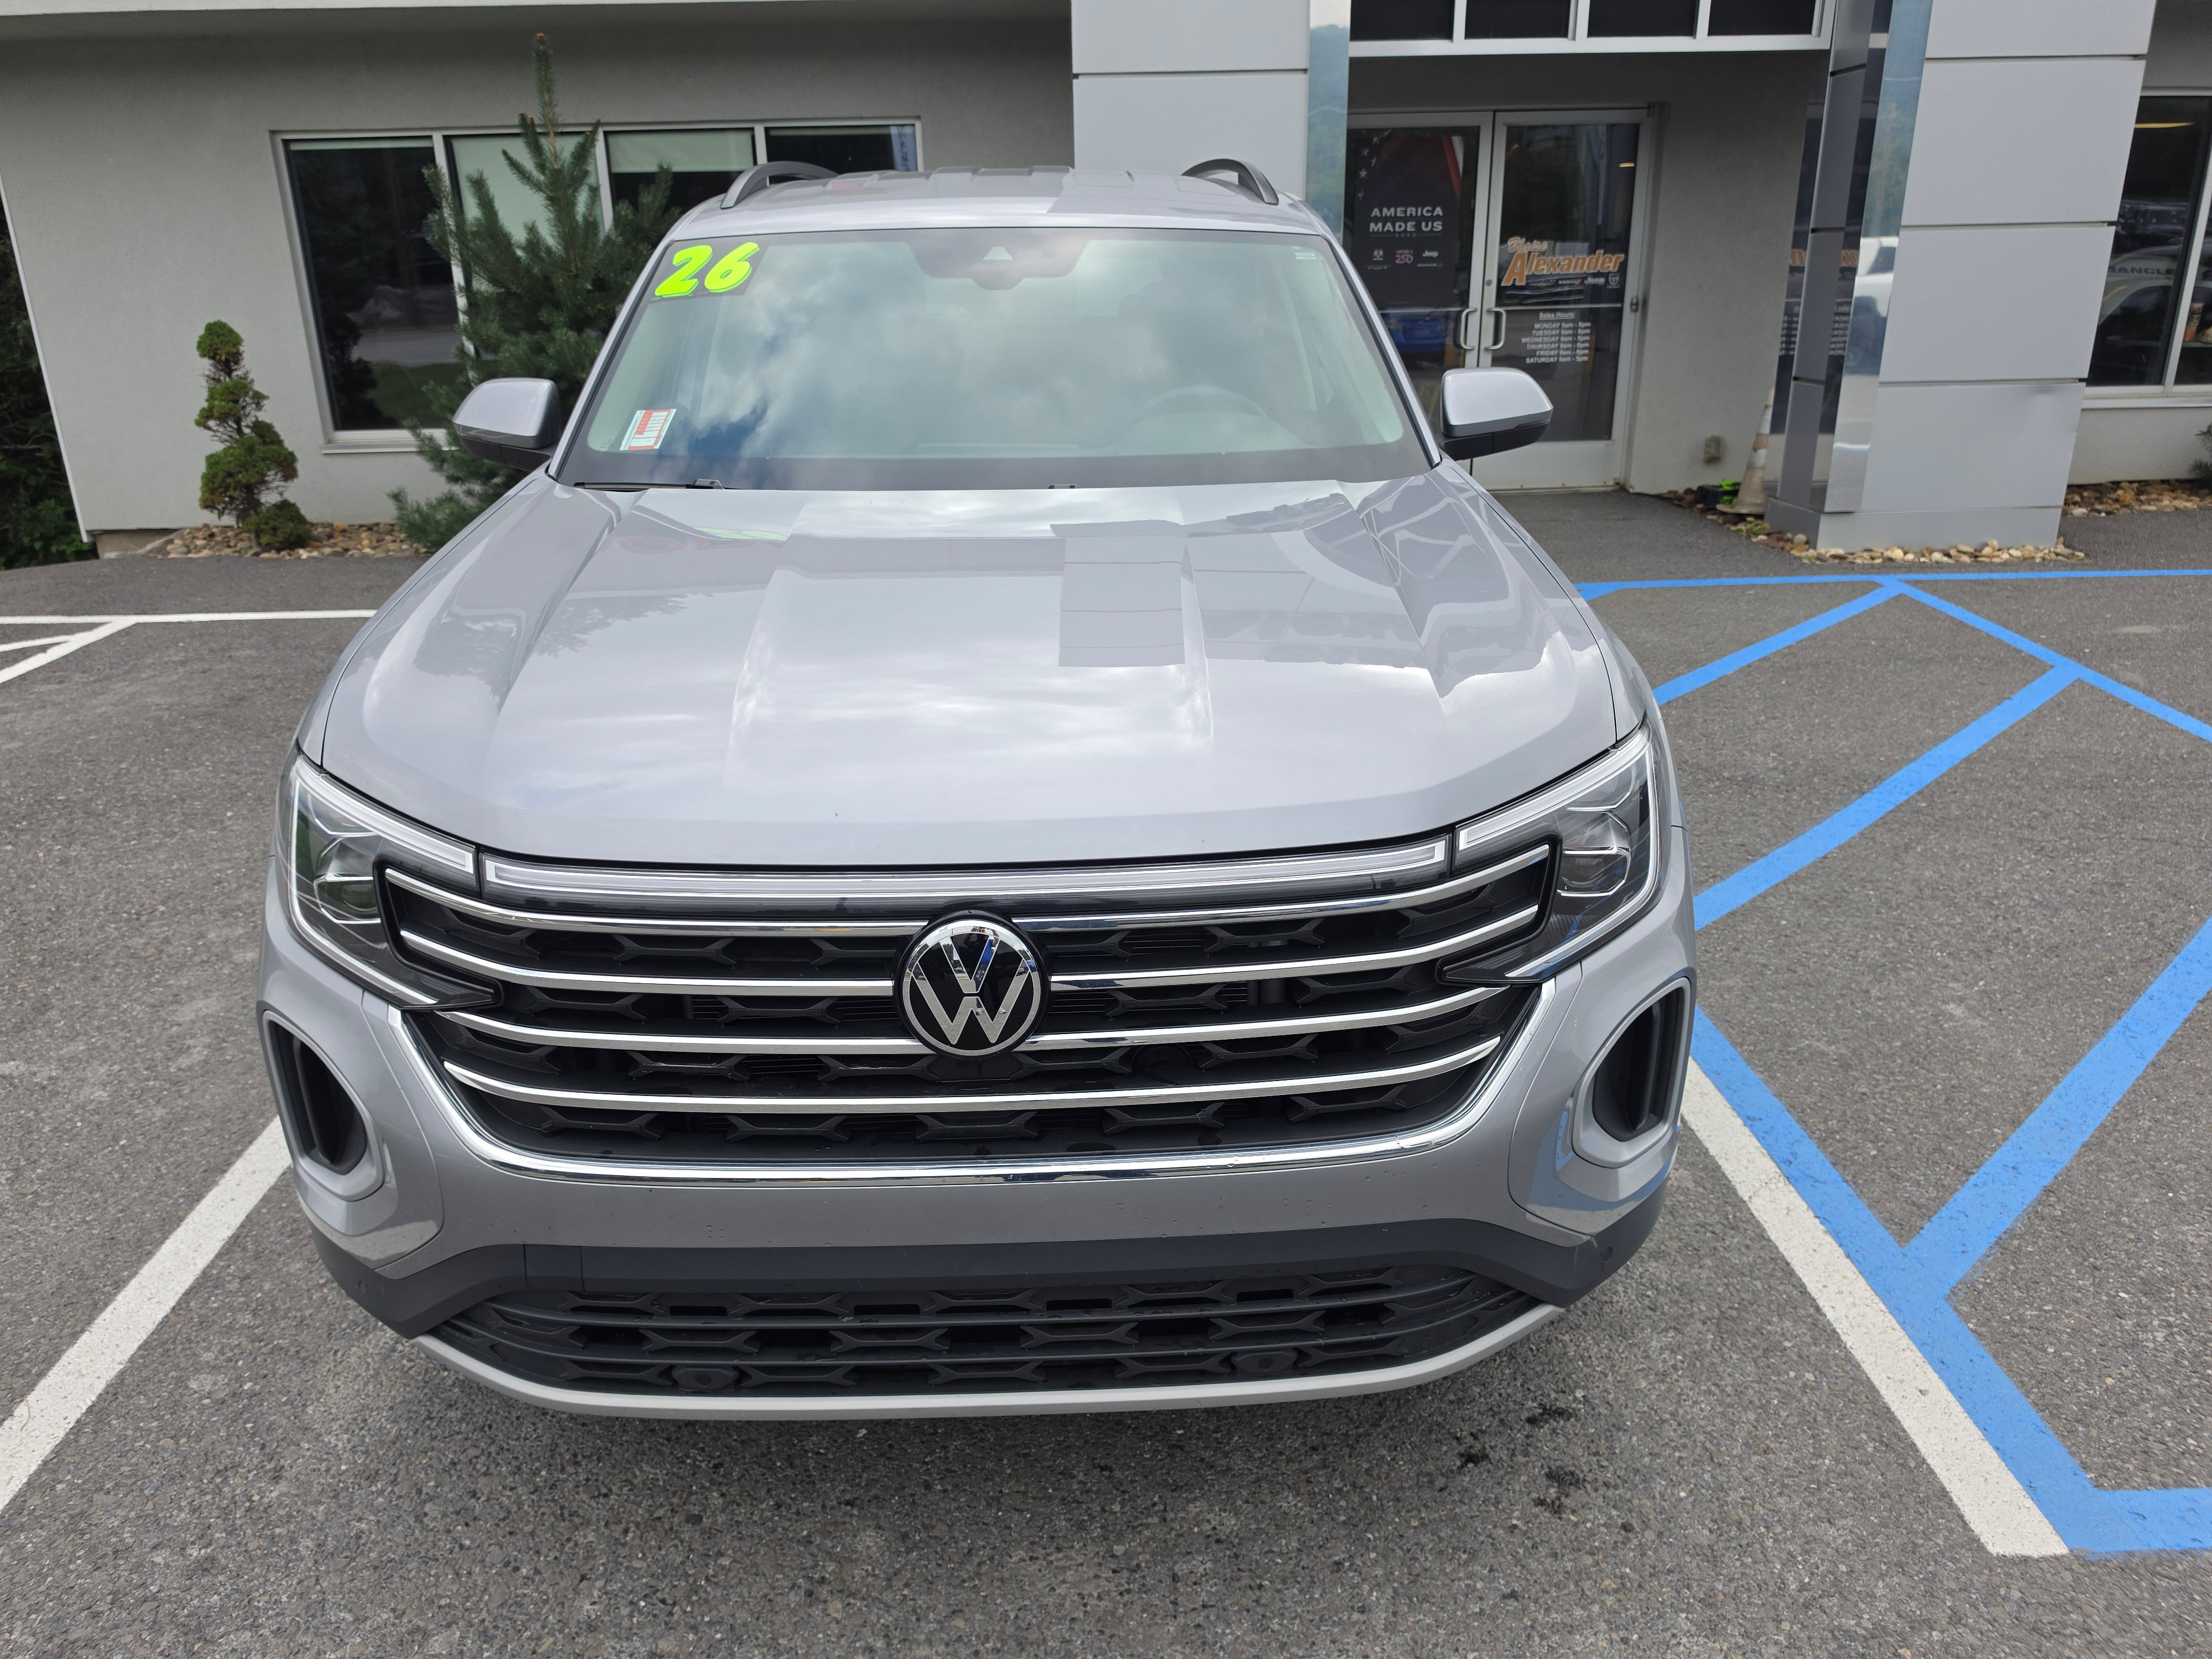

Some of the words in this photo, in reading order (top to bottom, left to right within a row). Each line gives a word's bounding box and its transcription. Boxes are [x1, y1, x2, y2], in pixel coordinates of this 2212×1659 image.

[1371, 206, 1443, 217] AMERICA
[1369, 221, 1416, 232] MADE
[1421, 221, 1443, 232] US
[655, 242, 760, 298] 26
[1501, 249, 1625, 286] Alexander
